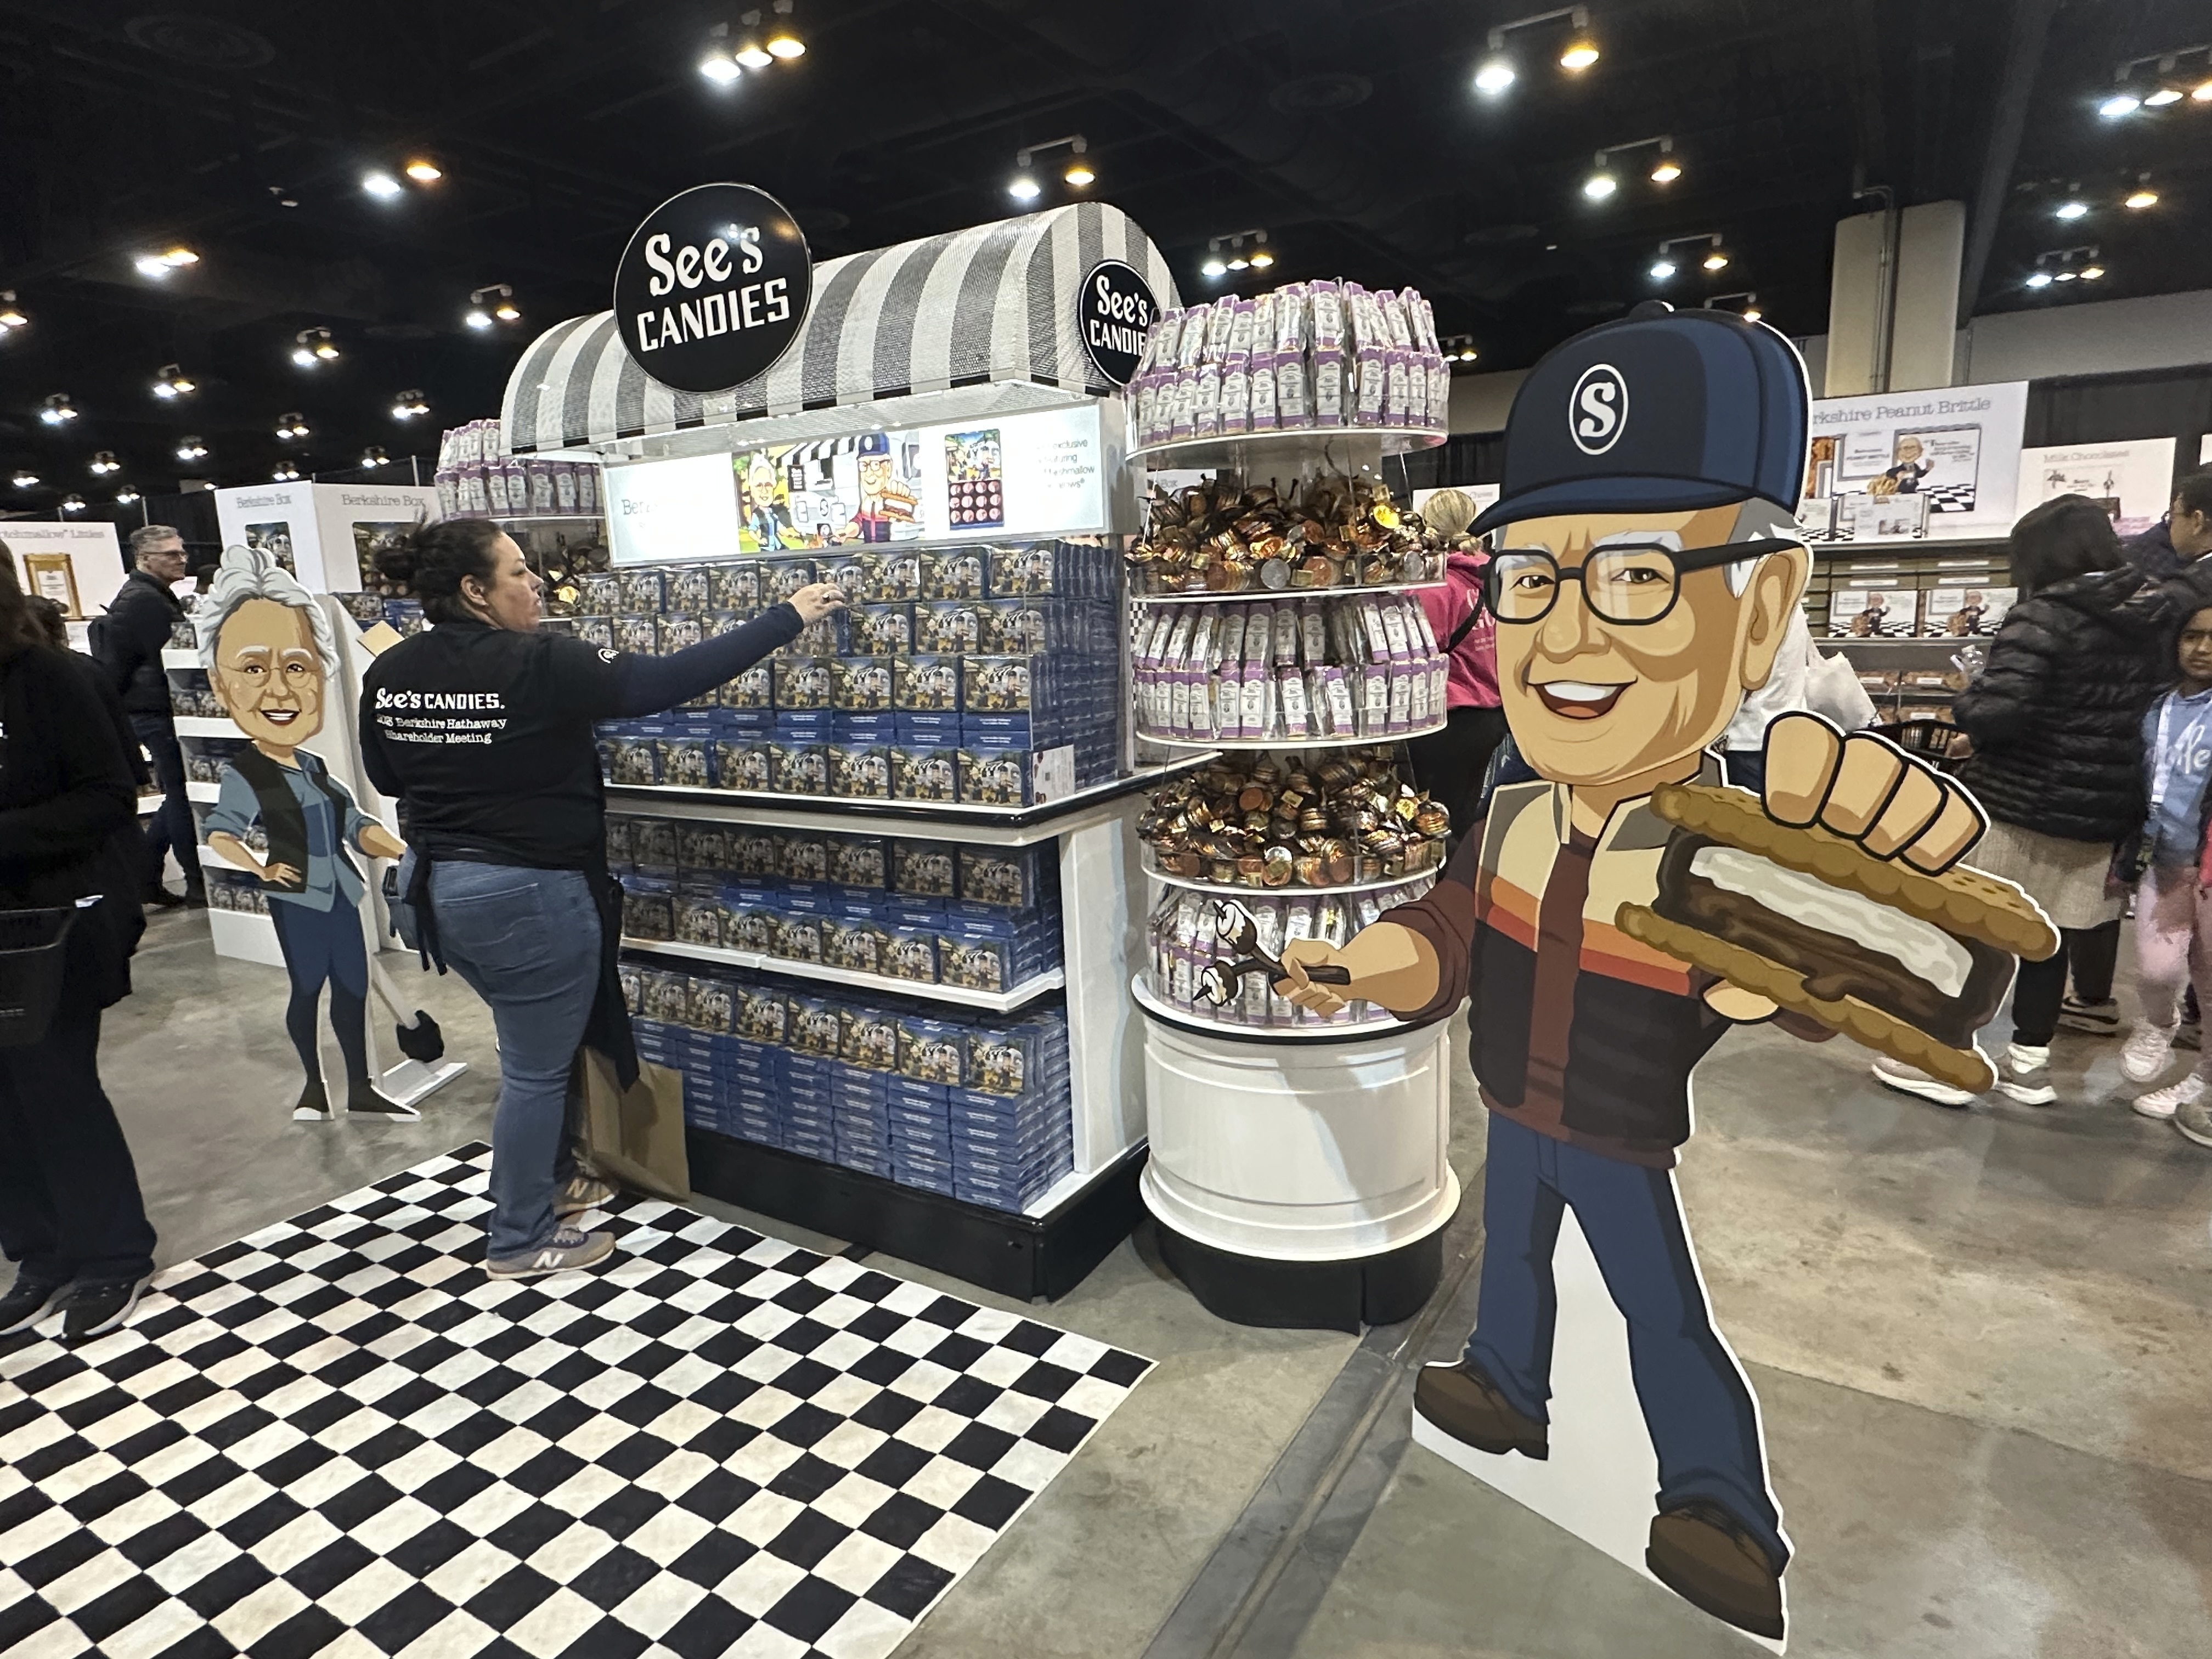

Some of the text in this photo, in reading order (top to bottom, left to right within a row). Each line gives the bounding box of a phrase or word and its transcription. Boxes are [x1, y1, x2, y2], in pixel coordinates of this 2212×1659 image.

[645, 223, 763, 297] See's
[1096, 274, 1148, 327] See's
[637, 277, 791, 352] CANDIES
[1090, 318, 1147, 357] CANDIE
[1579, 382, 1616, 438] S
[1813, 397, 1991, 426] rkshire Peanut Brittle
[275, 493, 292, 505] Box
[341, 493, 425, 507] Berkshire Box
[375, 687, 422, 709] See's
[447, 718, 507, 730] Hathaway
[445, 732, 493, 744] Meeting
[532, 1251, 565, 1268] N
